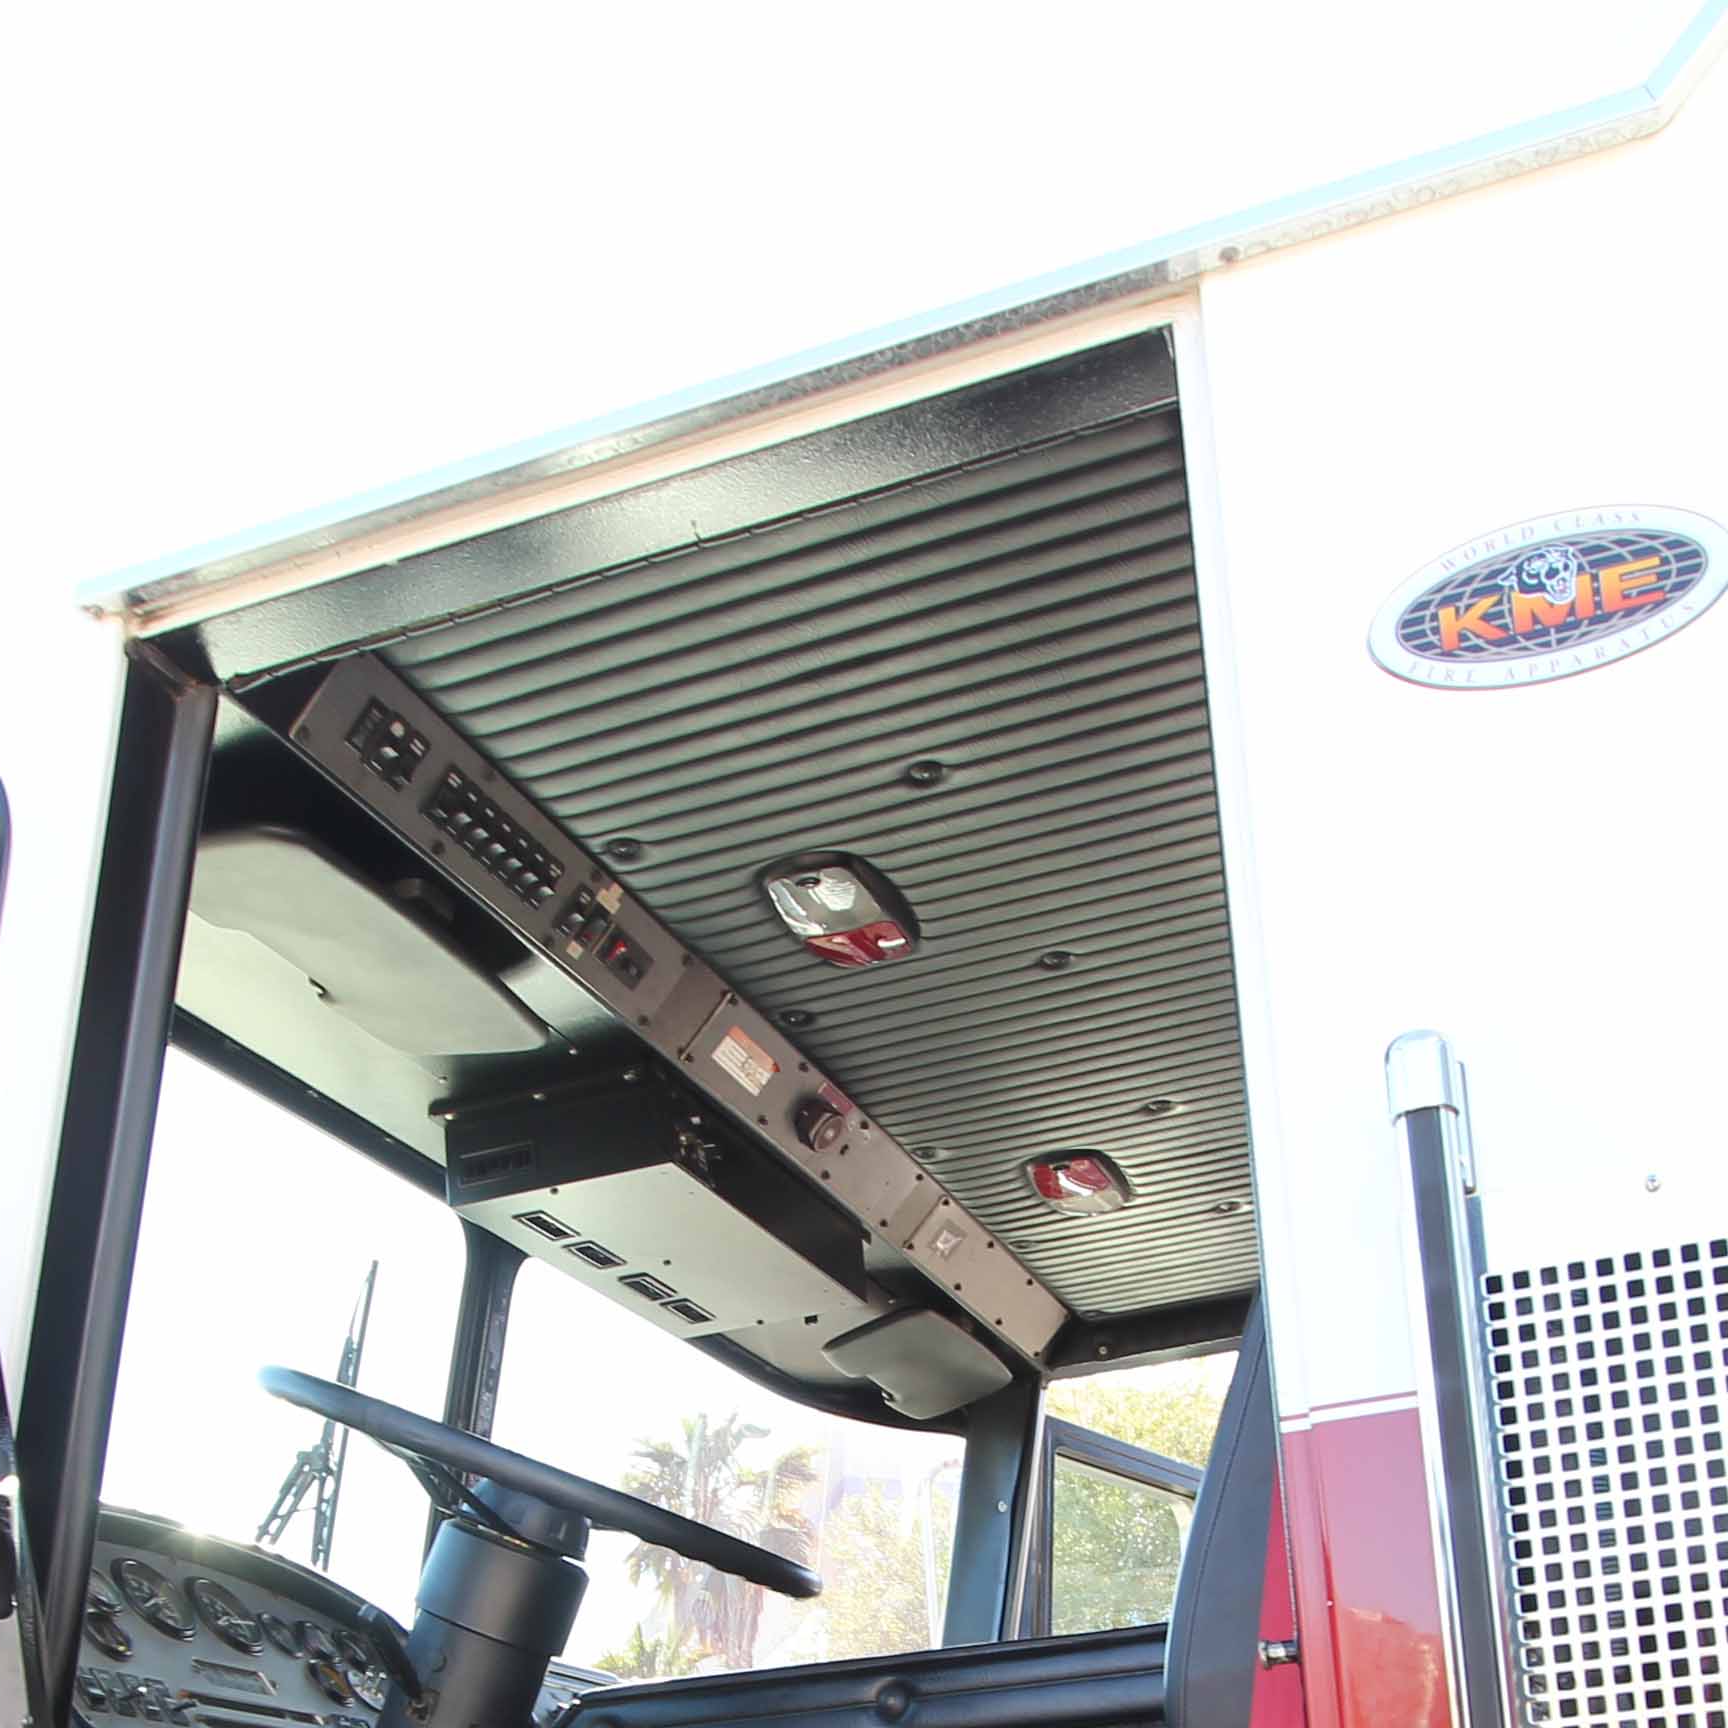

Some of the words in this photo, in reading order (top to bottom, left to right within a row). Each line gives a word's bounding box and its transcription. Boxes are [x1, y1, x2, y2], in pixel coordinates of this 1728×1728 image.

[1439, 525, 1536, 573] WORLD
[1552, 511, 1642, 533] CLASS
[1406, 662, 1478, 683] FIRE
[1503, 601, 1698, 681] APPARATUS
[1436, 555, 1667, 652] KME
